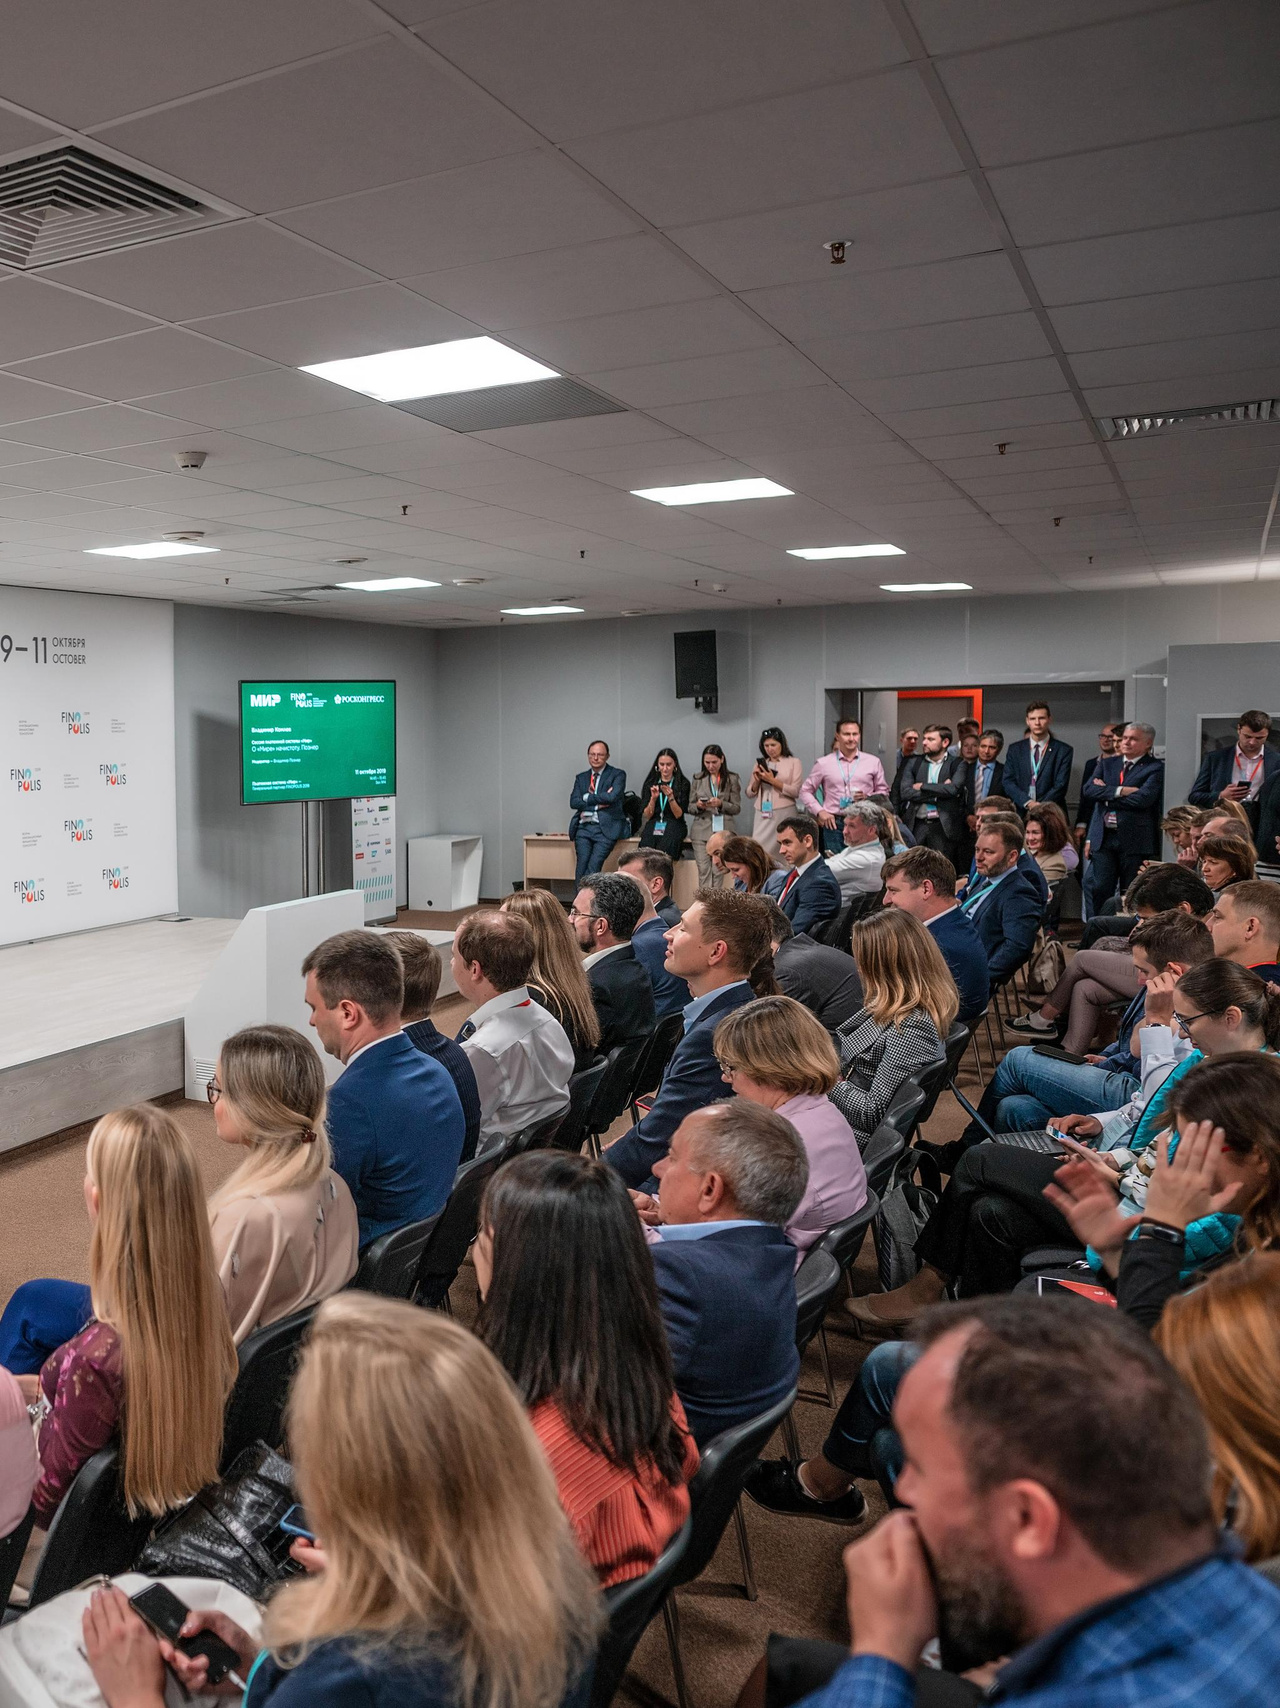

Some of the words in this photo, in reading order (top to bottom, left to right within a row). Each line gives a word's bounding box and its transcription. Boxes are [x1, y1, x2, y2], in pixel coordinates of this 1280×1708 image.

[52, 637, 85, 648] ОКТЯБРЯ
[52, 653, 86, 664] OCTOBER
[250, 694, 282, 707] МИР
[342, 695, 385, 703] РОСКОНГРЕСС
[61, 712, 81, 723] FINO
[68, 723, 90, 734] POLIS
[10, 768, 32, 780] FINO
[99, 764, 118, 775] FINO
[18, 779, 41, 792] POLIS
[106, 774, 126, 786] POLIS
[64, 819, 84, 831] FINO
[71, 829, 93, 842] POLIS
[102, 867, 121, 880] FINO
[14, 880, 35, 893] FINO
[109, 877, 129, 889] POLIS
[21, 889, 45, 904] POLIS
